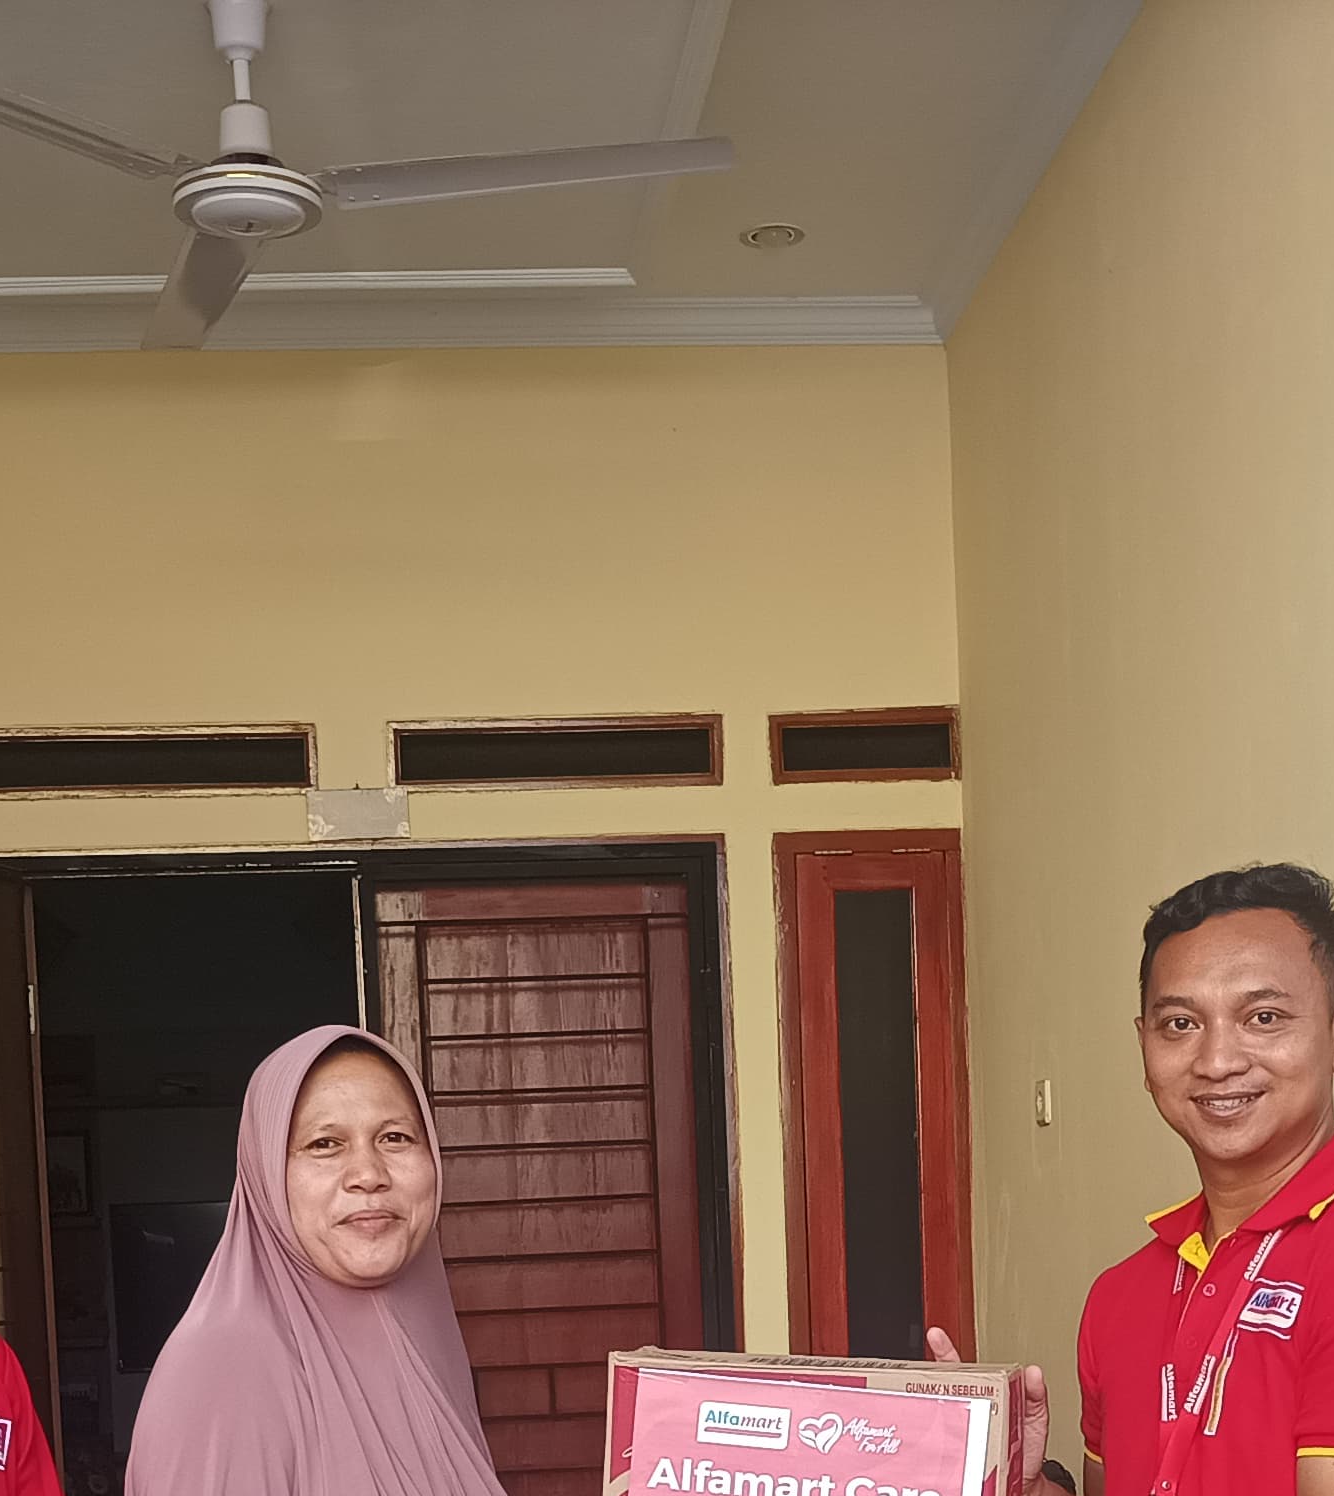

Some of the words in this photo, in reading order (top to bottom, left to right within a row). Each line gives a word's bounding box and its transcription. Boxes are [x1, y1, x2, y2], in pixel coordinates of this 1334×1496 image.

[1166, 1363, 1178, 1421] Alfamart
[1184, 1354, 1213, 1412] Alfamart
[704, 1409, 783, 1431] Alfamart
[843, 1416, 896, 1439] Alfamart
[877, 1438, 903, 1455] All
